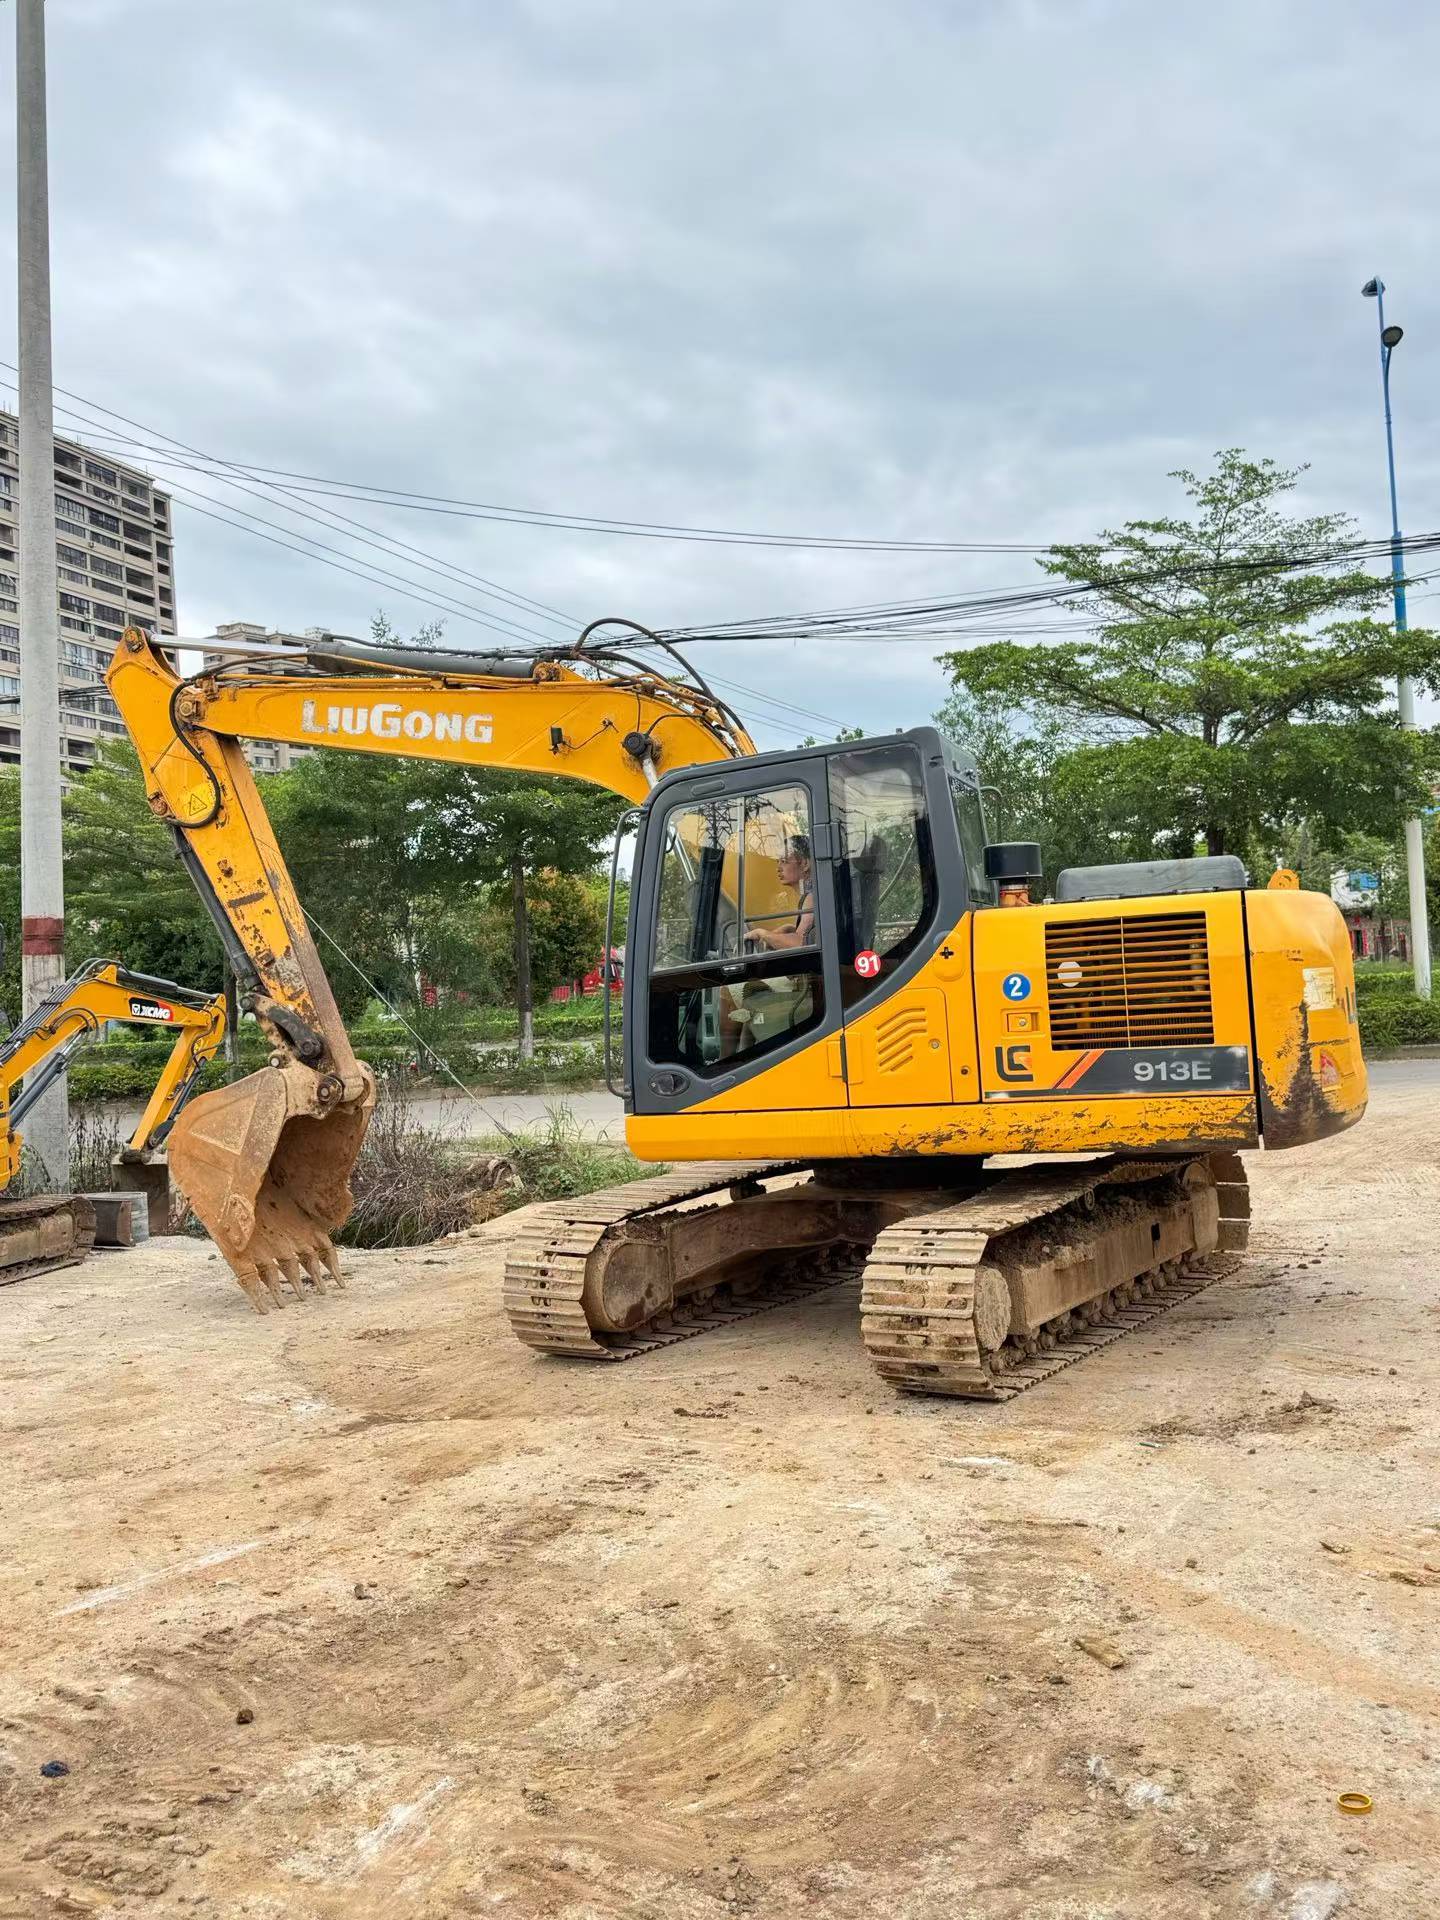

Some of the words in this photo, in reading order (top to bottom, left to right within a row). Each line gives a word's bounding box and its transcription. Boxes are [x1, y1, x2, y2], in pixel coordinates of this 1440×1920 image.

[857, 955, 880, 974] 91
[1009, 977, 1023, 997] 2
[141, 1005, 171, 1020] XCMG
[1133, 1061, 1212, 1082] 913E
